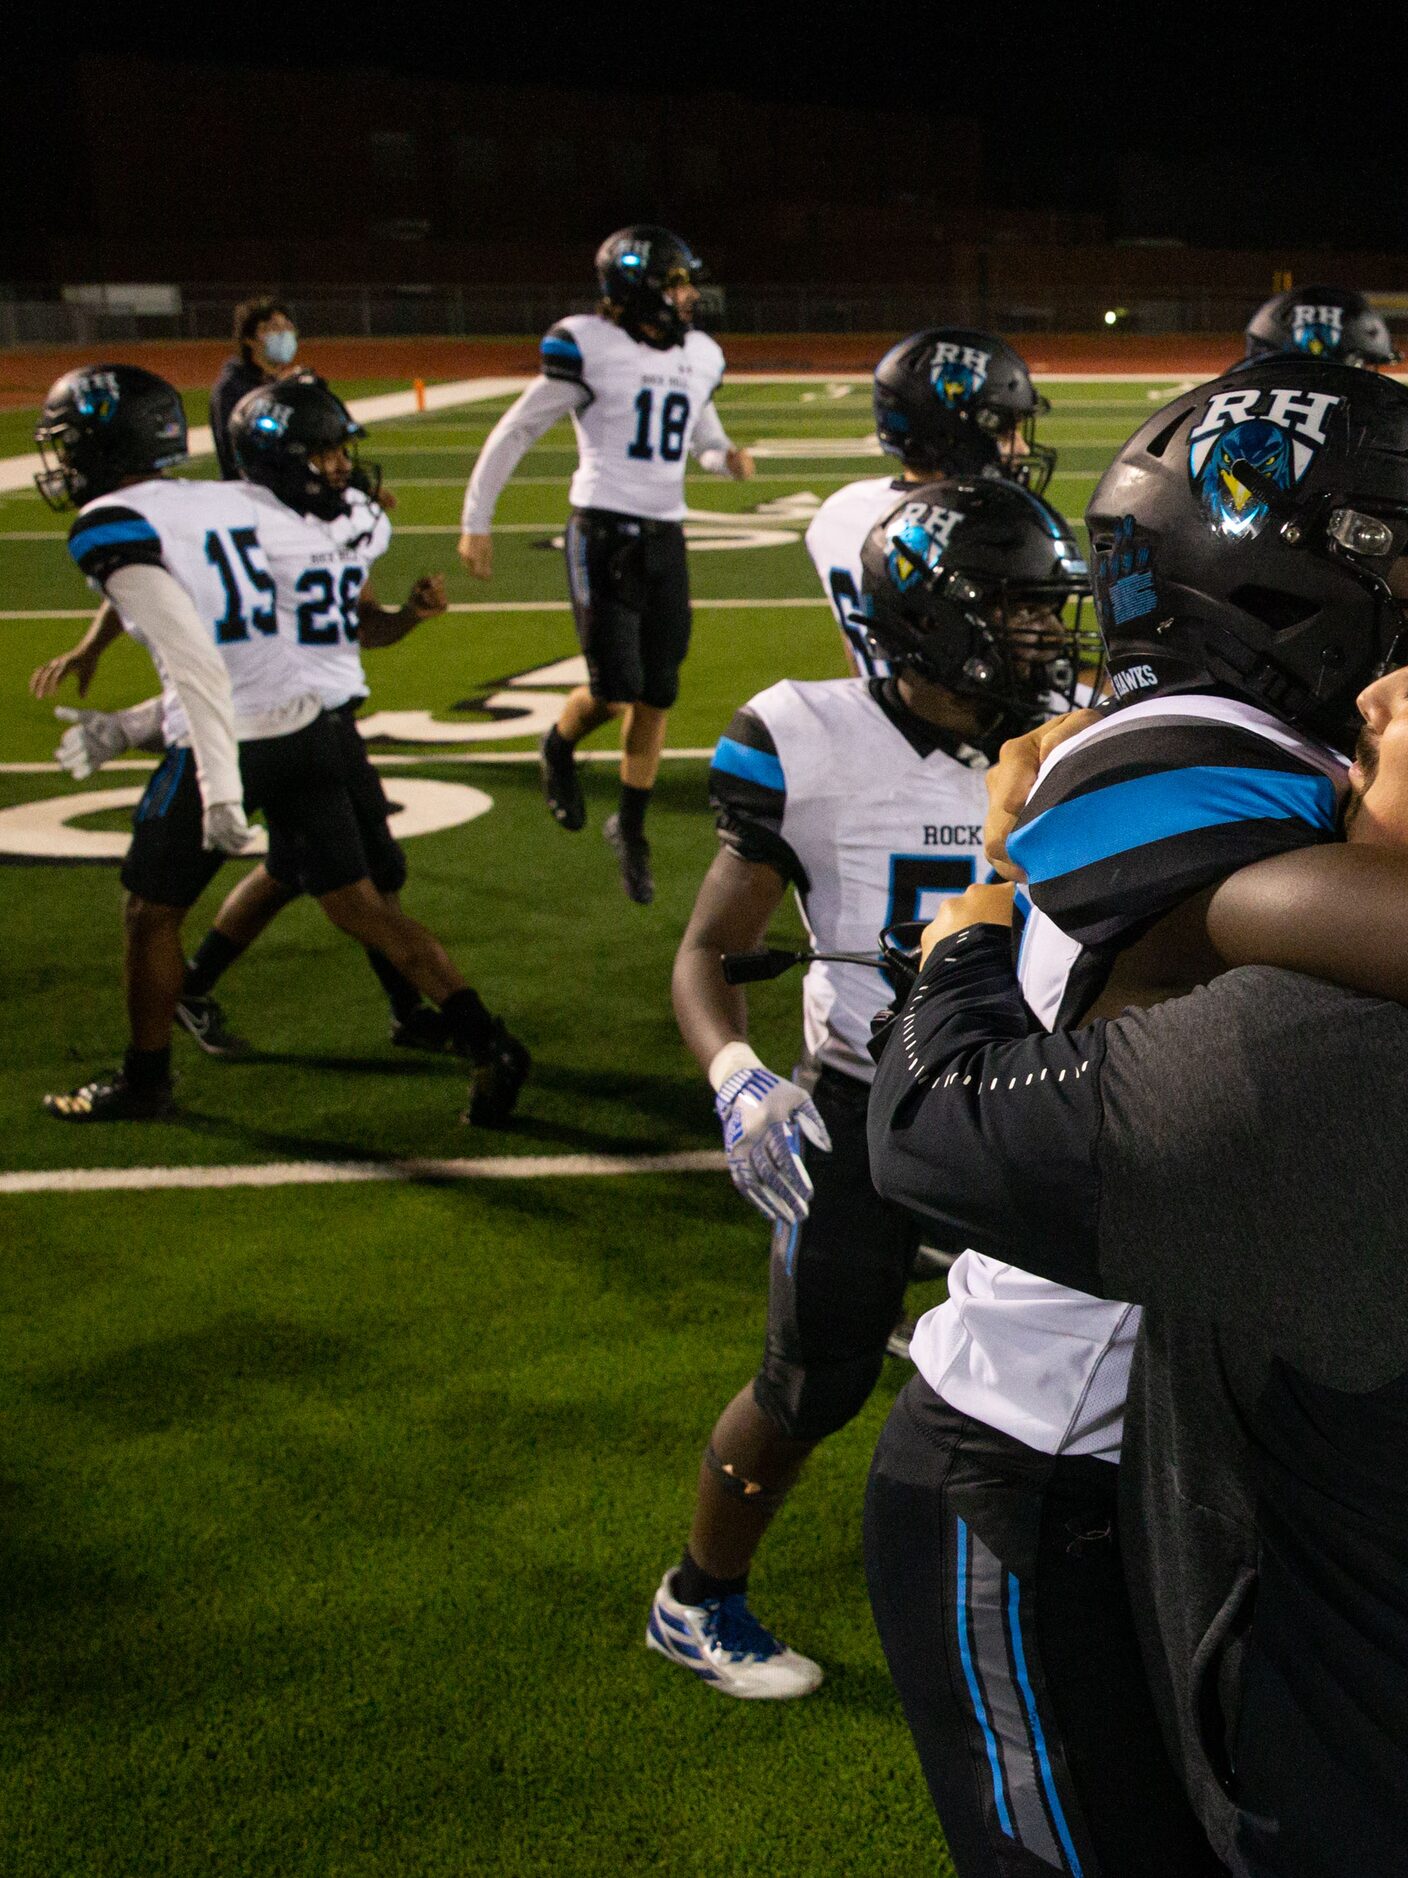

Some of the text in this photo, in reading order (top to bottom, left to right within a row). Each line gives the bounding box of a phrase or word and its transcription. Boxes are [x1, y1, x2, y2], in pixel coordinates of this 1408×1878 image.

[1292, 304, 1344, 331] RH
[931, 342, 992, 372] RH
[626, 386, 691, 463] 18
[1190, 388, 1341, 445] RH
[899, 501, 965, 550] RH
[204, 525, 279, 645] 15
[1112, 664, 1160, 700] HAWKS
[922, 824, 983, 846] ROCK
